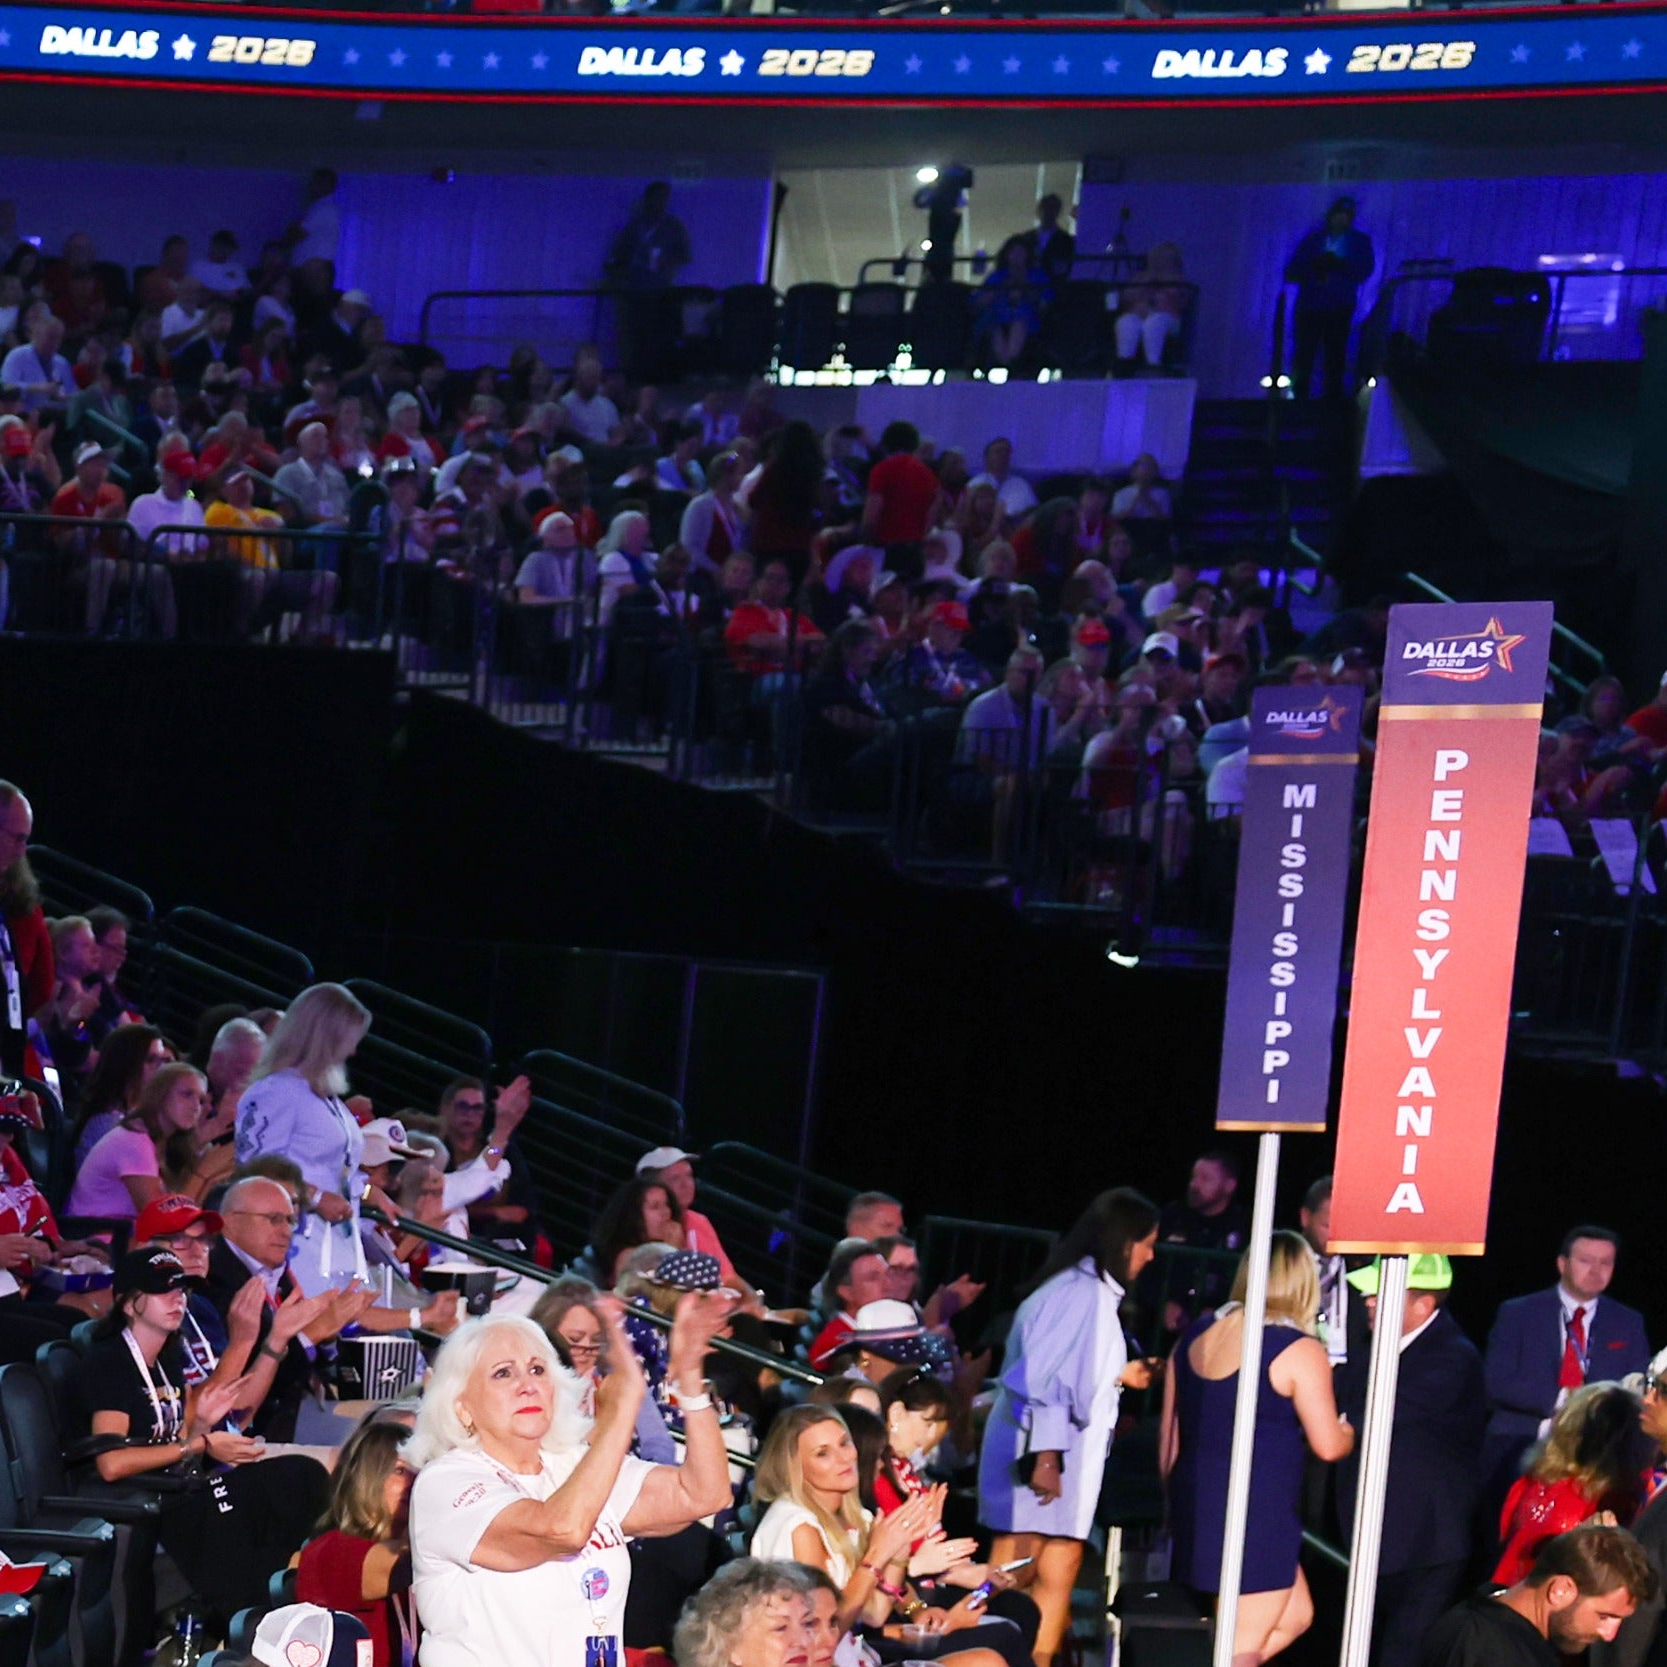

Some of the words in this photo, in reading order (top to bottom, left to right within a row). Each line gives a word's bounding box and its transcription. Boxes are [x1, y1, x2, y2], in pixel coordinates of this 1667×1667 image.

[39, 25, 160, 60] DALLAS
[207, 35, 317, 67] 2026
[577, 46, 706, 77] DALLAS
[758, 49, 875, 76] 2026
[1151, 47, 1289, 79] DALLAS
[1346, 41, 1476, 73] 2026
[1402, 640, 1494, 659] DALLAS
[1427, 658, 1466, 668] 2026
[1266, 710, 1327, 723] DALLAS
[1262, 783, 1316, 1104] MISSISSIPPI
[1383, 749, 1470, 1214] PENNSYLVANIA
